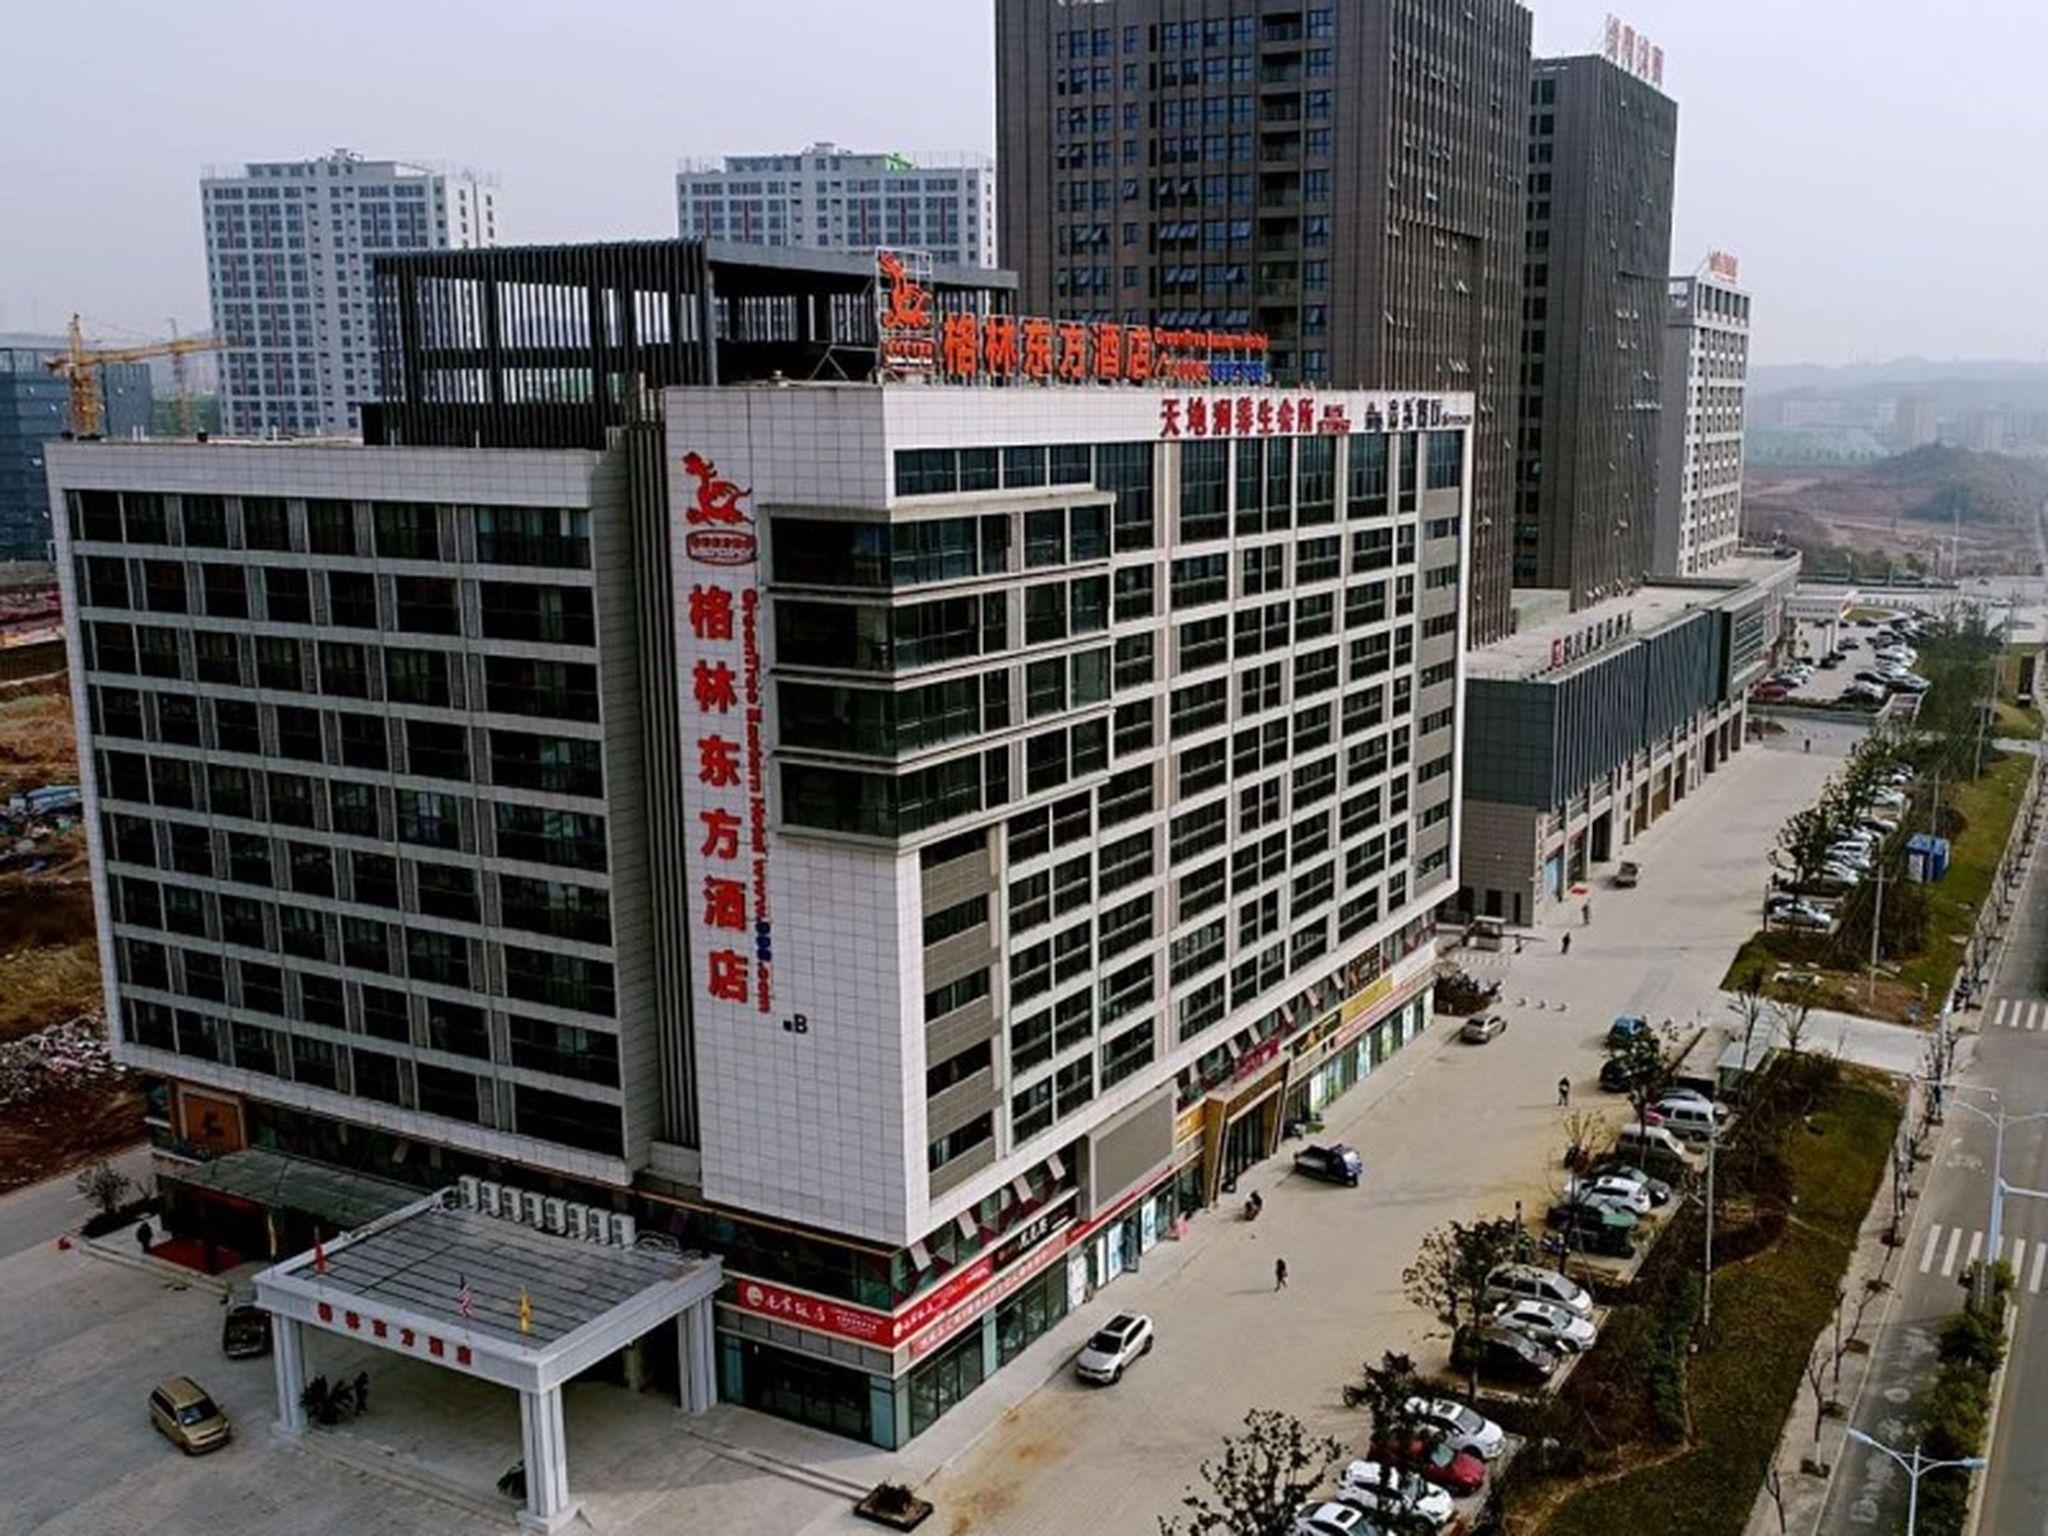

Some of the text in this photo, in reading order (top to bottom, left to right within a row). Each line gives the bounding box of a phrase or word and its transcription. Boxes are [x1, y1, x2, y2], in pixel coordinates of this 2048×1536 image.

[943, 315, 1153, 380] 格林东方酒店
[688, 583, 749, 1005] 格林东方酒店
